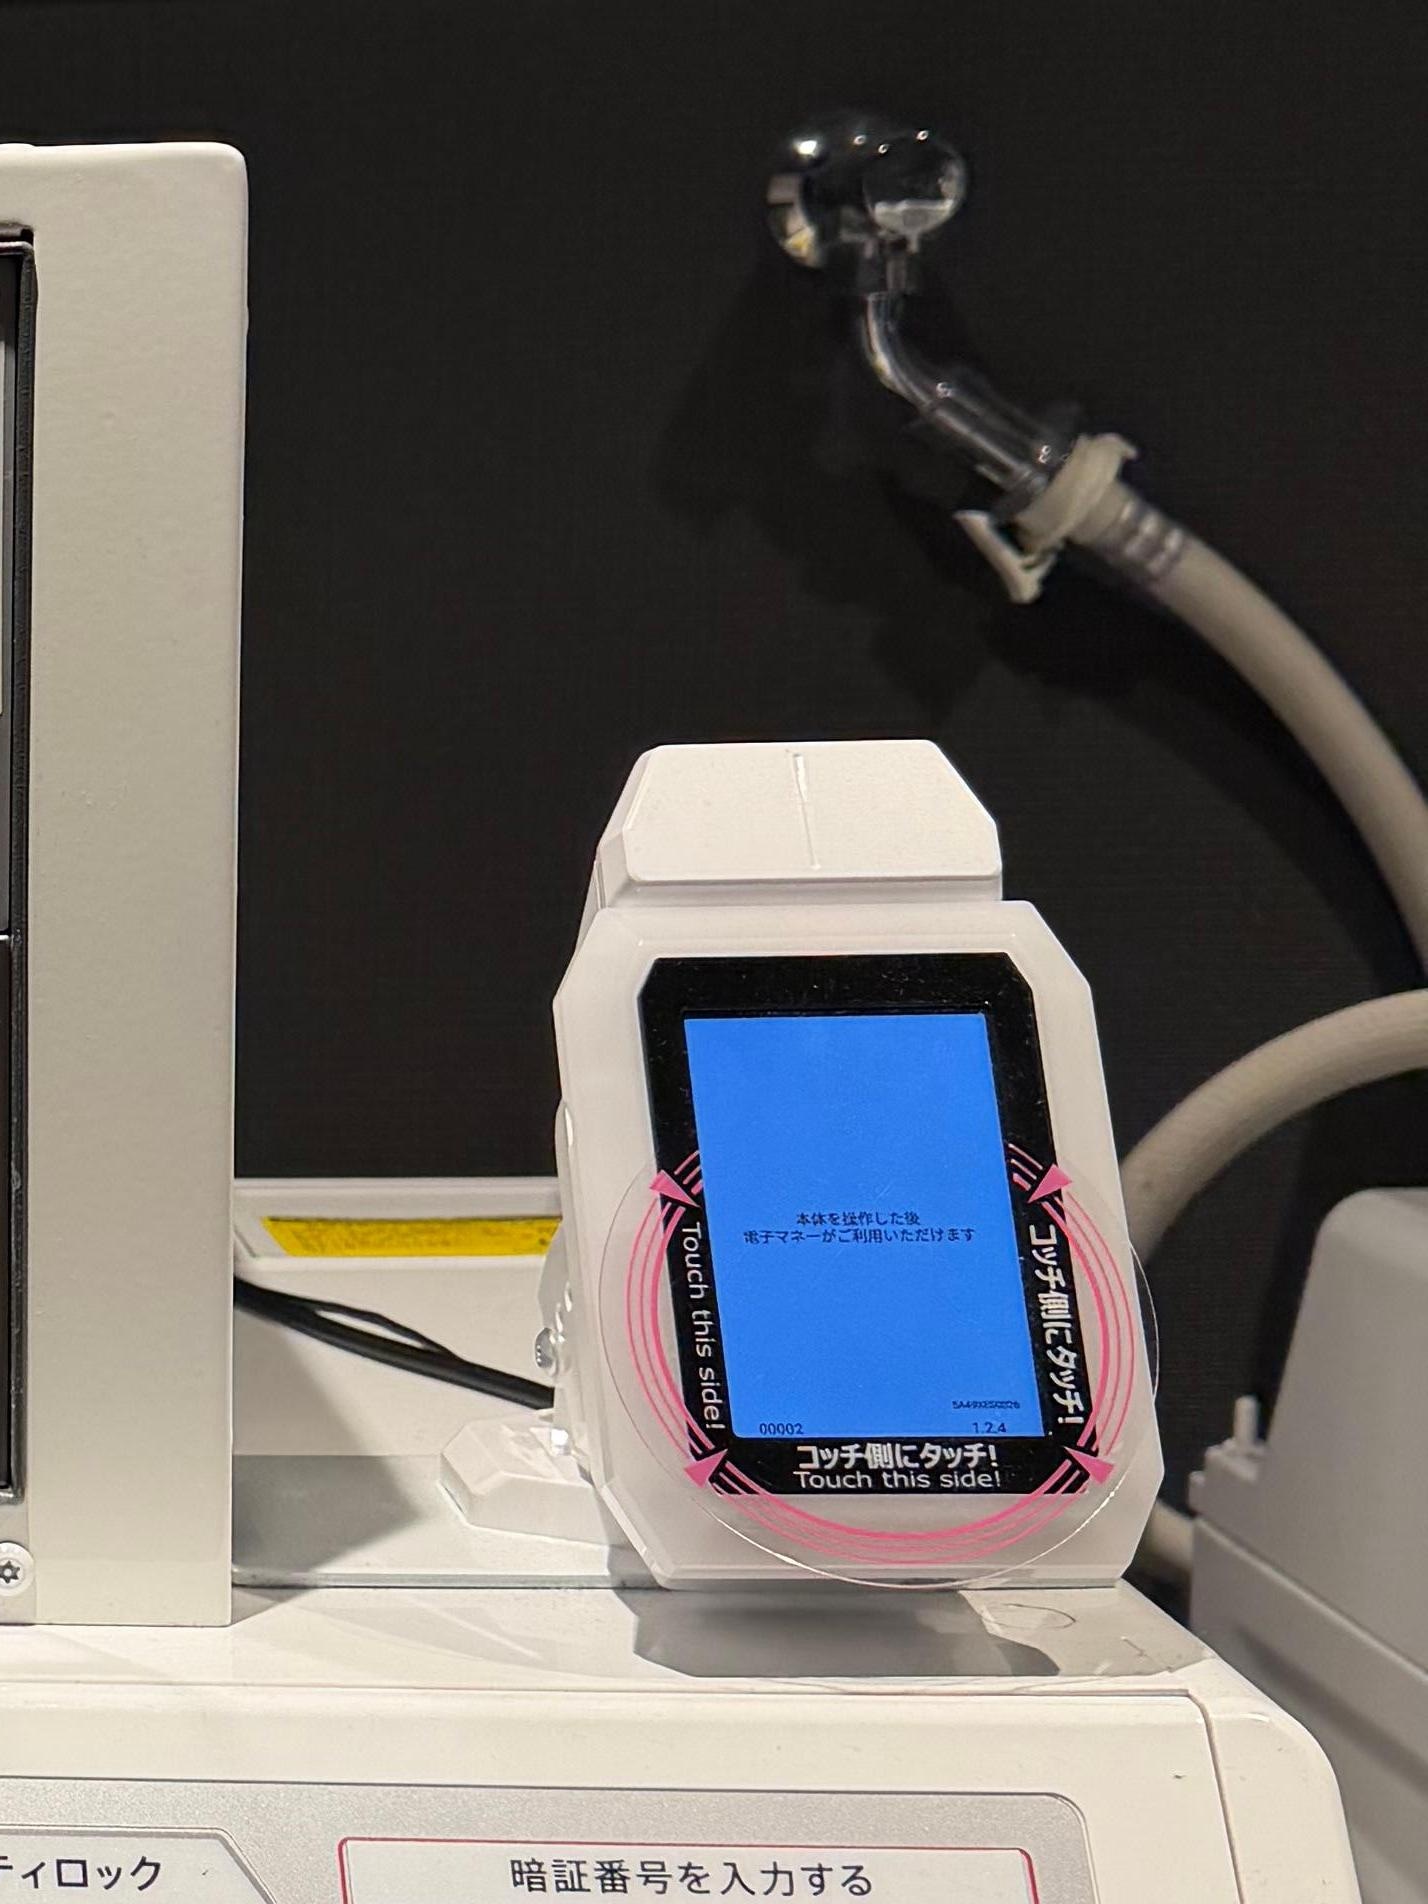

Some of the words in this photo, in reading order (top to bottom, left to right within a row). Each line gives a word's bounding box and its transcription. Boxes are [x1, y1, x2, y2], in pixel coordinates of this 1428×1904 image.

[795, 1210, 922, 1228] 本体を操作した後
[743, 1226, 976, 1246] 電子マネーがご利用いただけます
[680, 1221, 706, 1300] Touch
[691, 1308, 716, 1357] this
[700, 1365, 727, 1432] side!
[758, 1421, 806, 1437] 00002
[791, 1470, 874, 1491] Touch
[881, 1470, 932, 1491] this
[938, 1469, 1002, 1491] side!
[511, 1858, 874, 1899] 暗証番号を入力する
